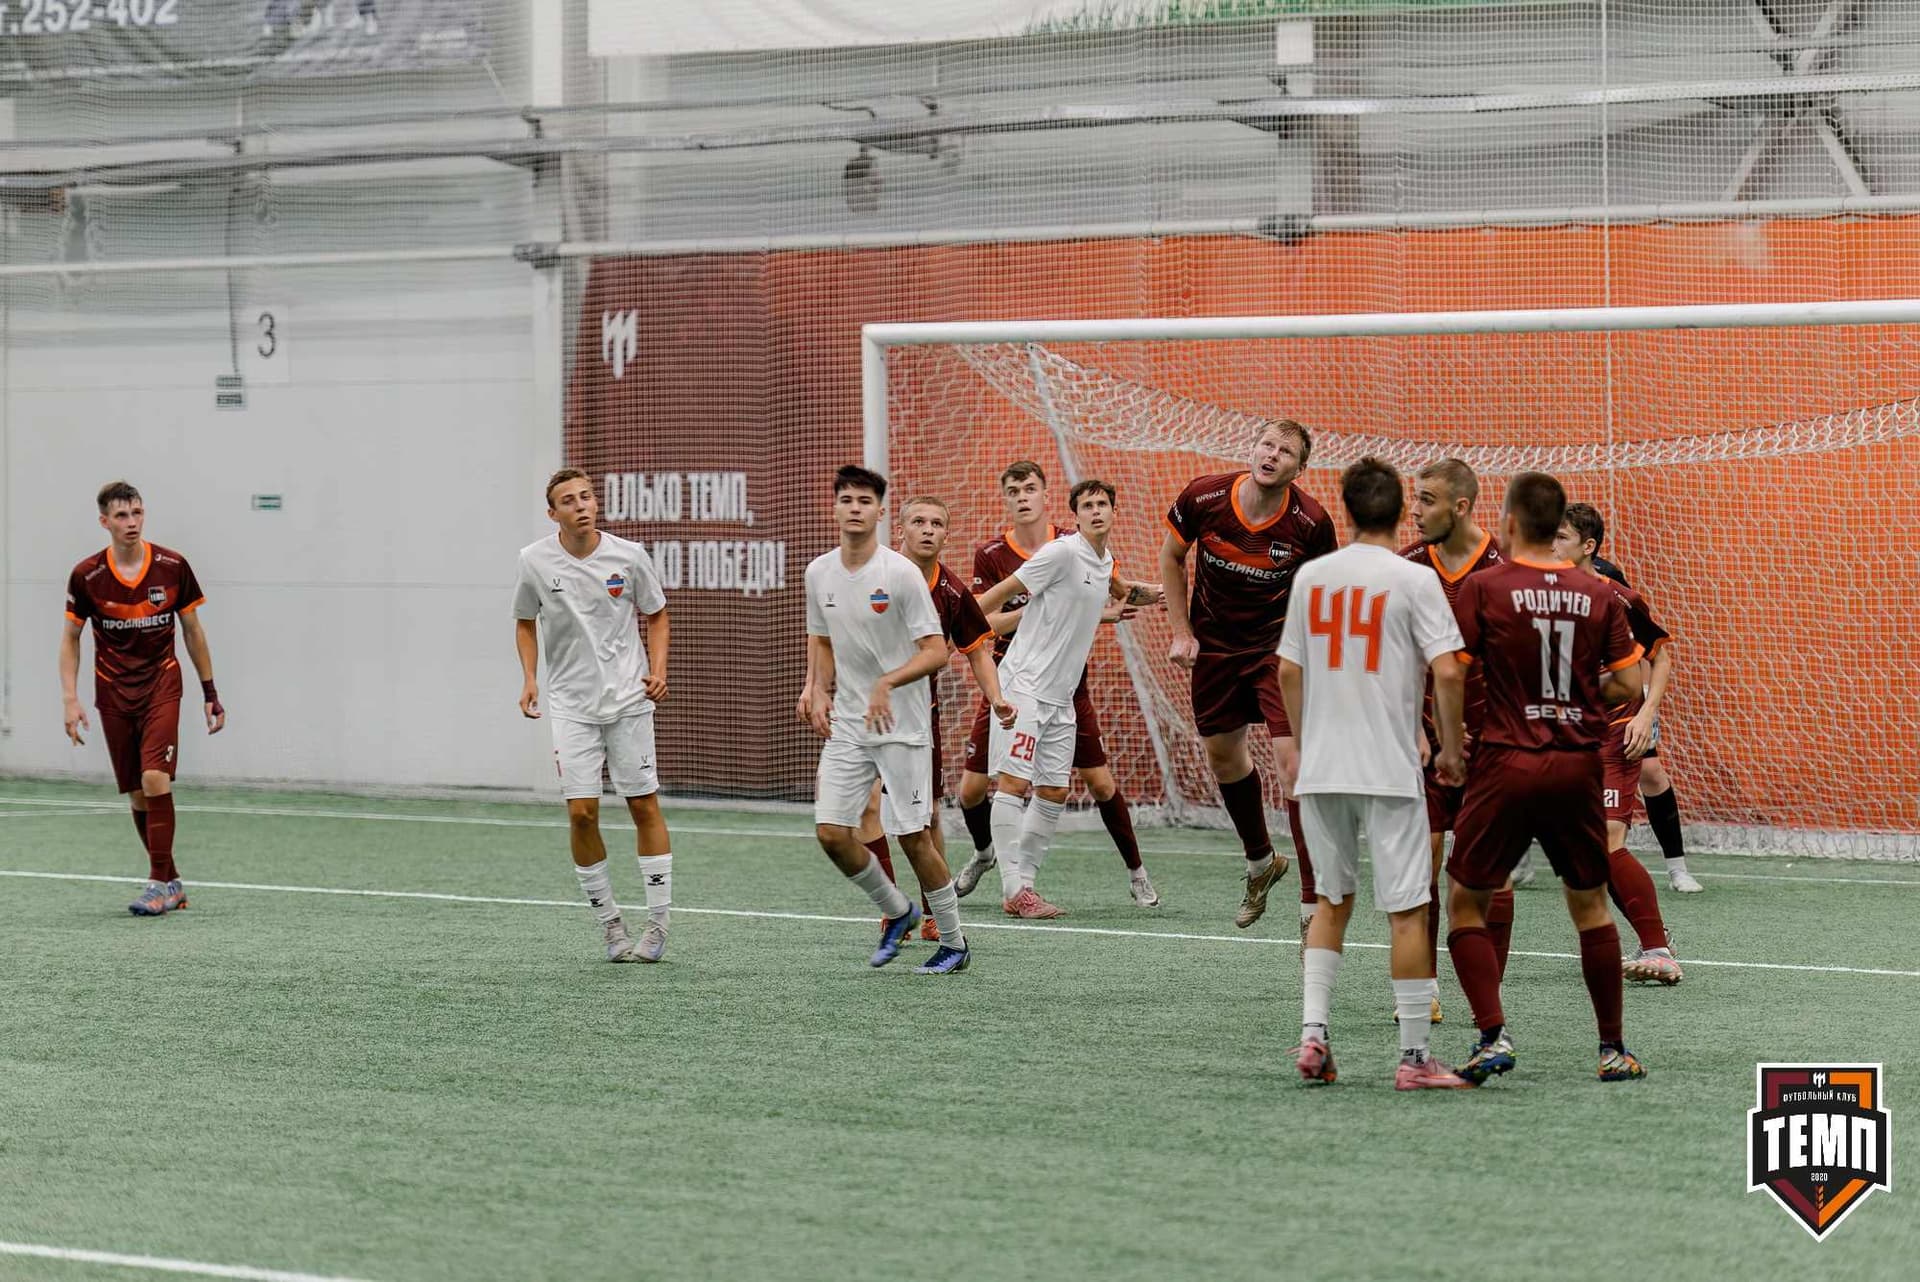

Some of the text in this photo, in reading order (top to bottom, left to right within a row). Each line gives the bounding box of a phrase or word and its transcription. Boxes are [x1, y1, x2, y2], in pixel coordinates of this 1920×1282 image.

[258, 312, 276, 358] 3
[604, 471, 755, 527] ОЛЬКО ТЕМП,
[688, 539, 786, 598] ПОБЕДА!
[1510, 587, 1592, 618] РОДИЧЕВ
[1308, 584, 1390, 674] 44
[1531, 617, 1576, 702] 11
[1009, 732, 1037, 762] 29
[1603, 789, 1620, 808] 21
